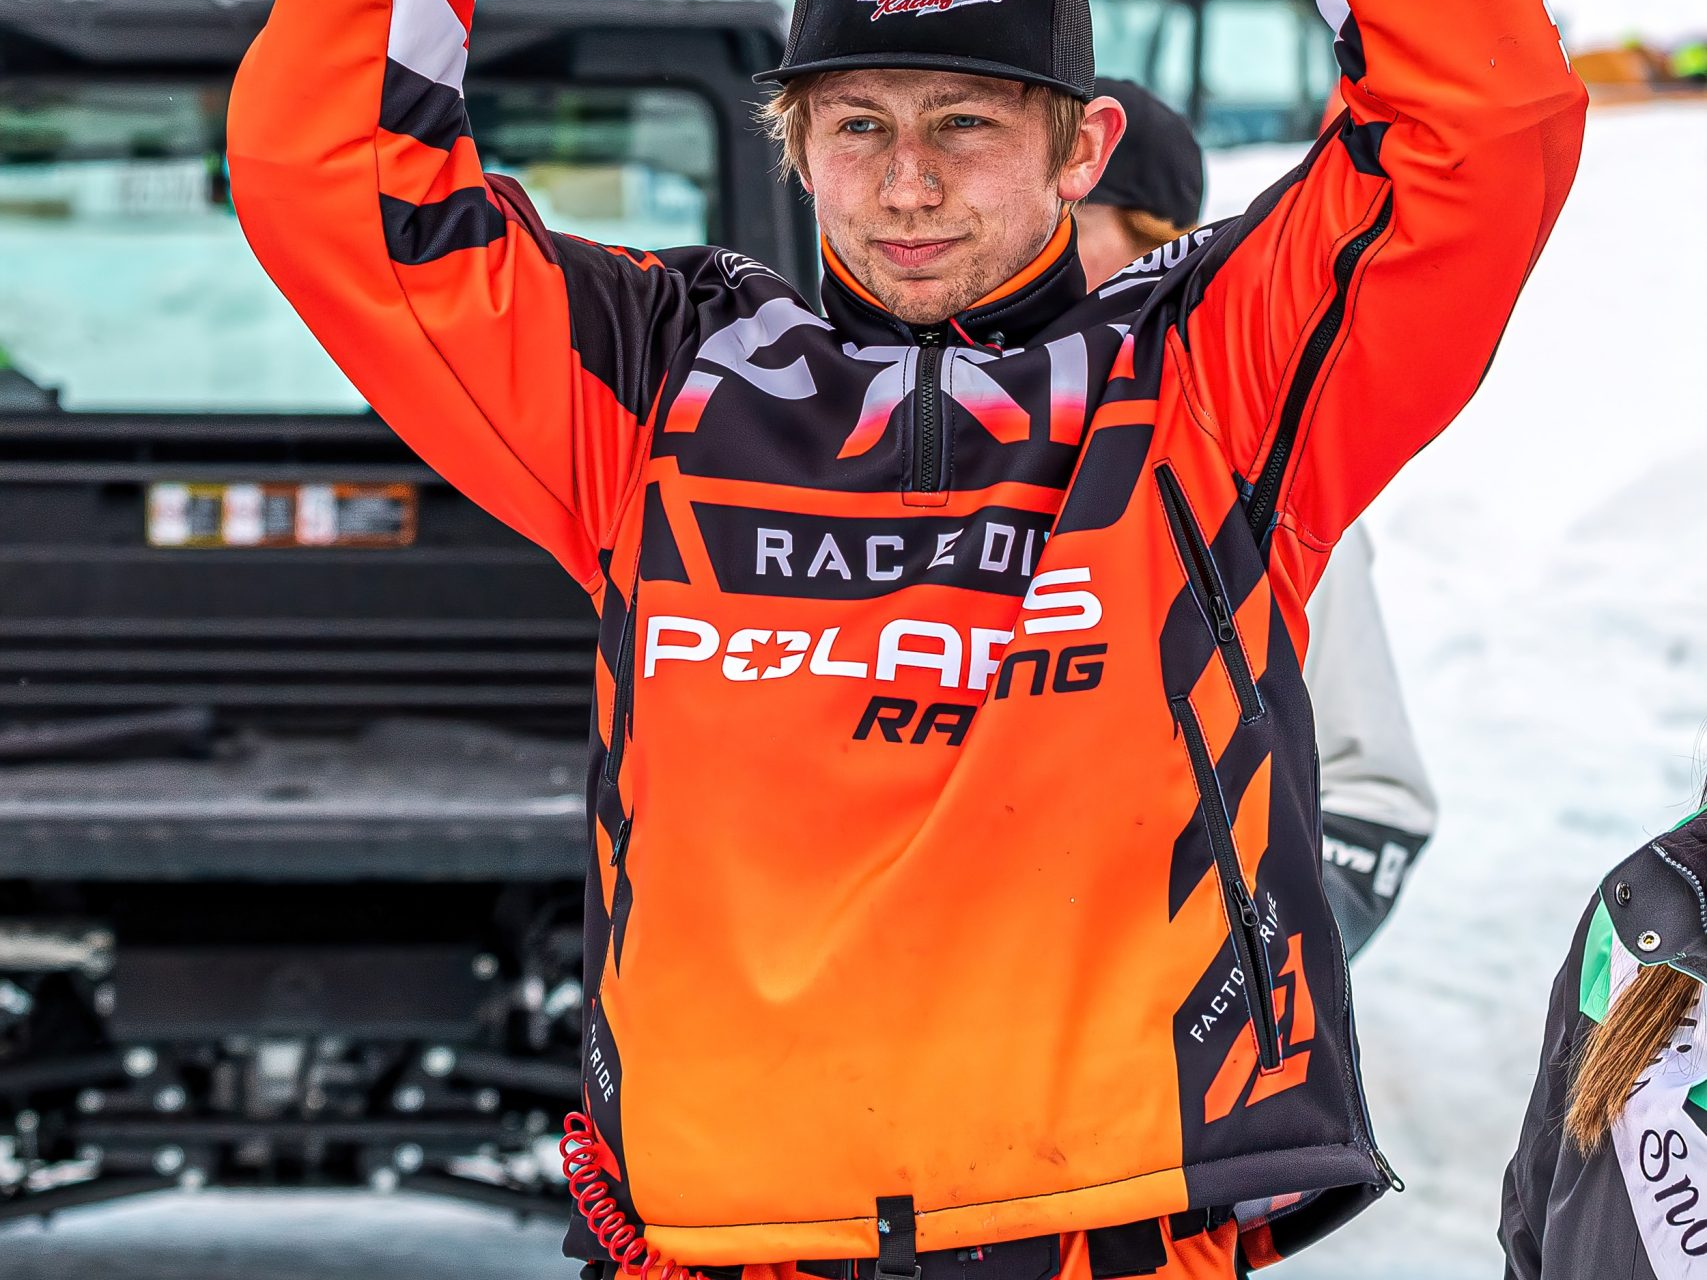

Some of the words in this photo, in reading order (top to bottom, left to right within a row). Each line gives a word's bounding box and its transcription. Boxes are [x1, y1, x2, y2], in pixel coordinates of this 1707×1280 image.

[755, 526, 965, 582] RACE
[978, 521, 1051, 577] DI
[852, 642, 1109, 746] RANG
[589, 1047, 614, 1103] RIDE
